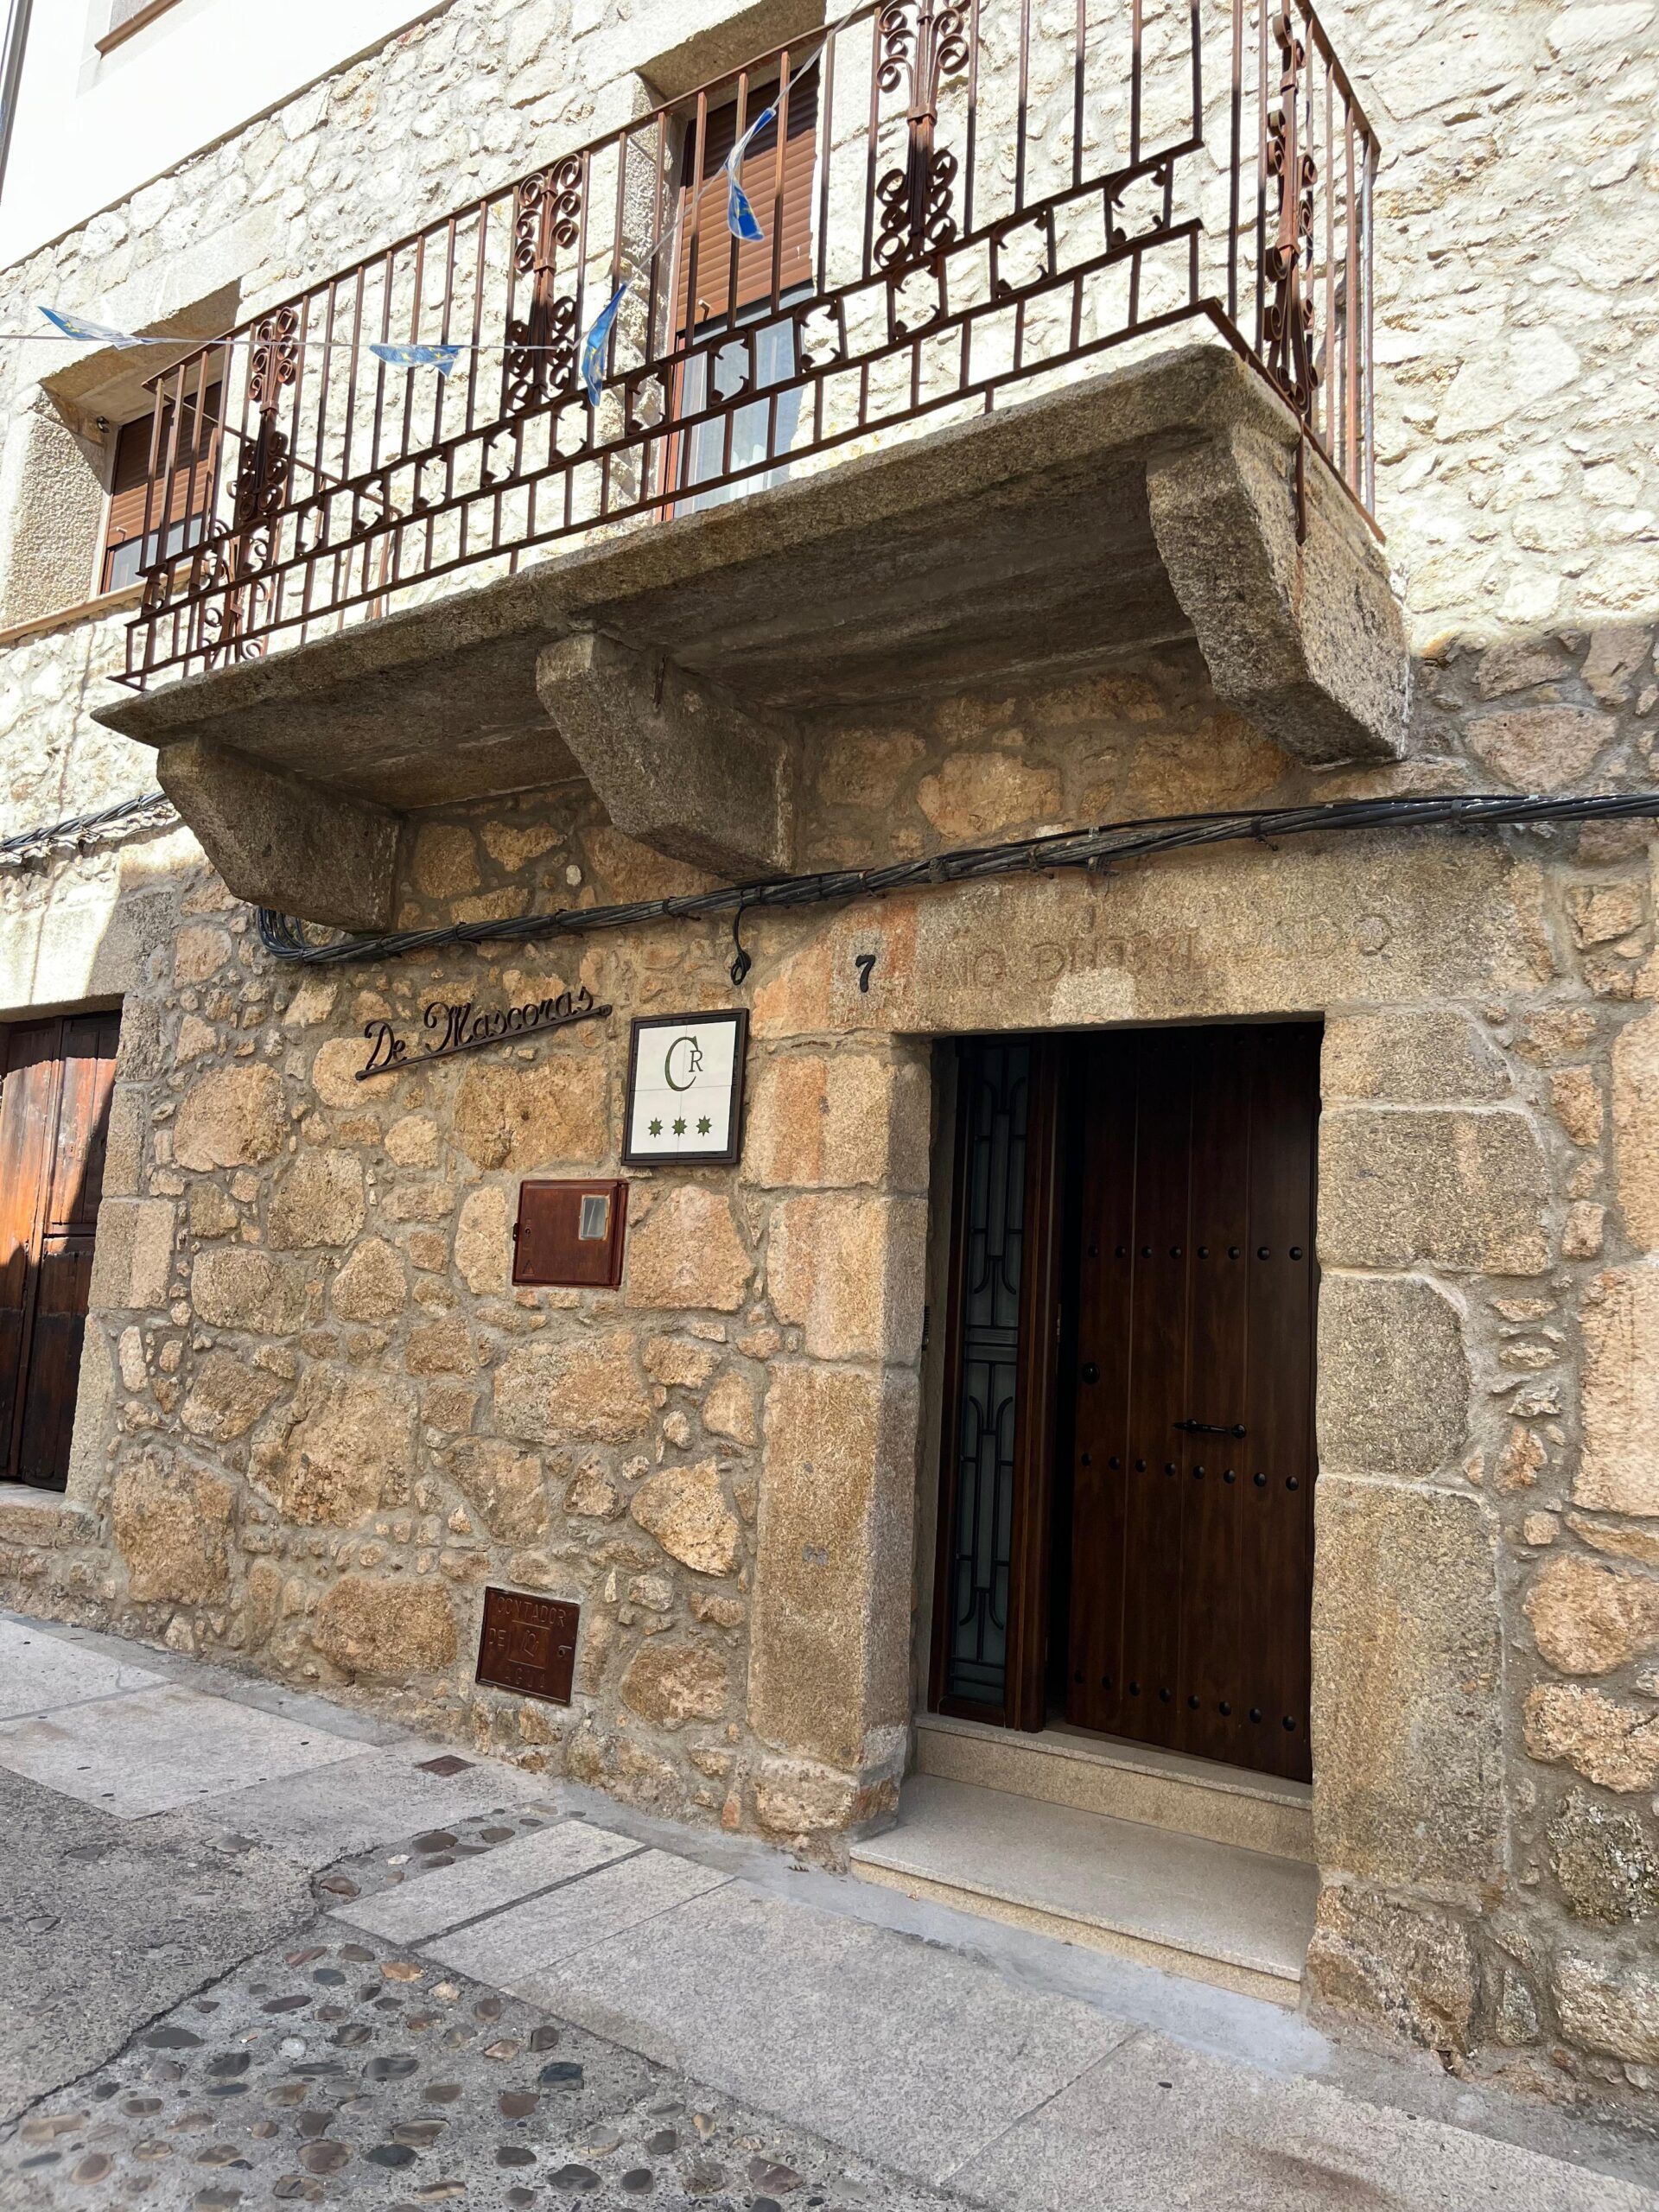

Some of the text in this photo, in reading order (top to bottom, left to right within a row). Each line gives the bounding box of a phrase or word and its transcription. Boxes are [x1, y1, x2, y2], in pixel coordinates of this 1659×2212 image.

[855, 955, 876, 993] 7
[364, 986, 594, 1071] De Mascoras
[498, 1596, 567, 1628] CONTADOR
[489, 1627, 507, 1649] DE
